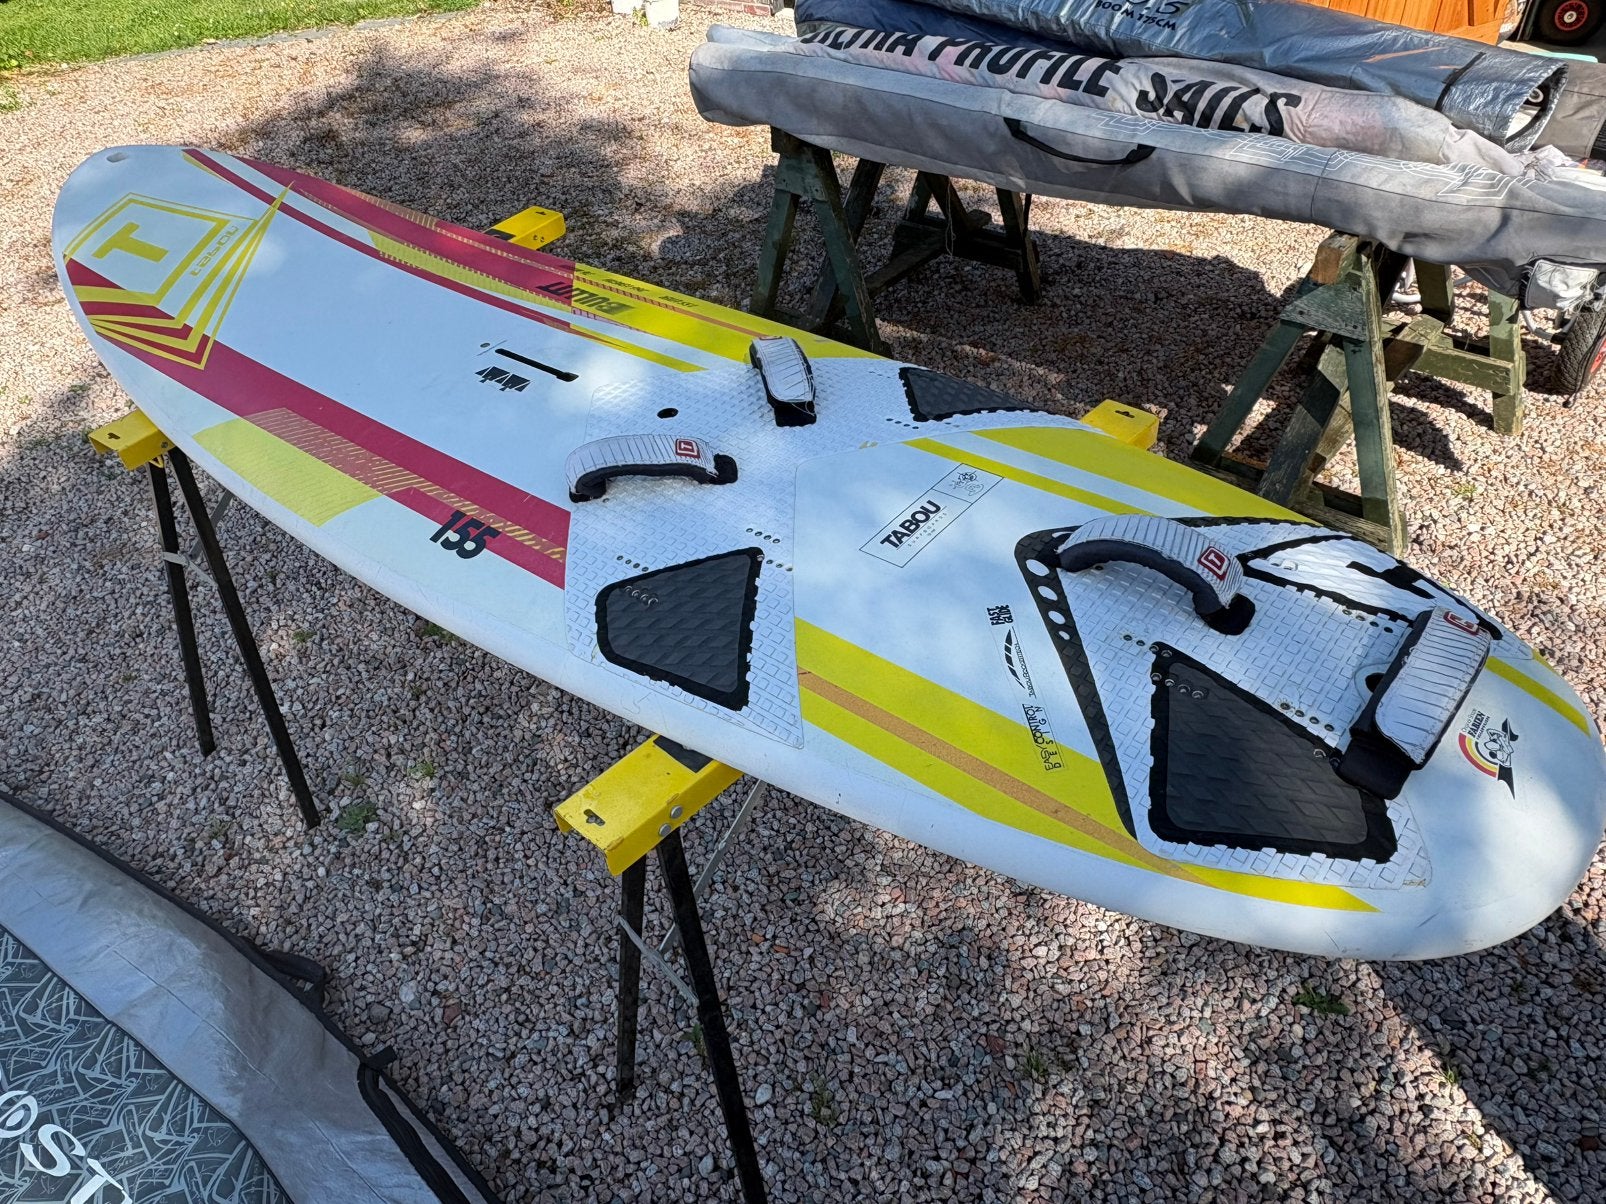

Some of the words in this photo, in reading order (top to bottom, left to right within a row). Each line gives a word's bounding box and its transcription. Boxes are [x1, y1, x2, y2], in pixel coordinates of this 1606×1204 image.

[1136, 13, 1177, 31] 175CM
[927, 37, 1123, 98] PROFILE
[1136, 72, 1302, 137] SAILS
[429, 509, 500, 559] 155
[880, 500, 942, 549] TABOU
[987, 605, 1005, 626] FAST
[999, 604, 1014, 625] GLIDE
[1035, 706, 1062, 769] DESIGN
[1467, 710, 1486, 739] FABIEN
